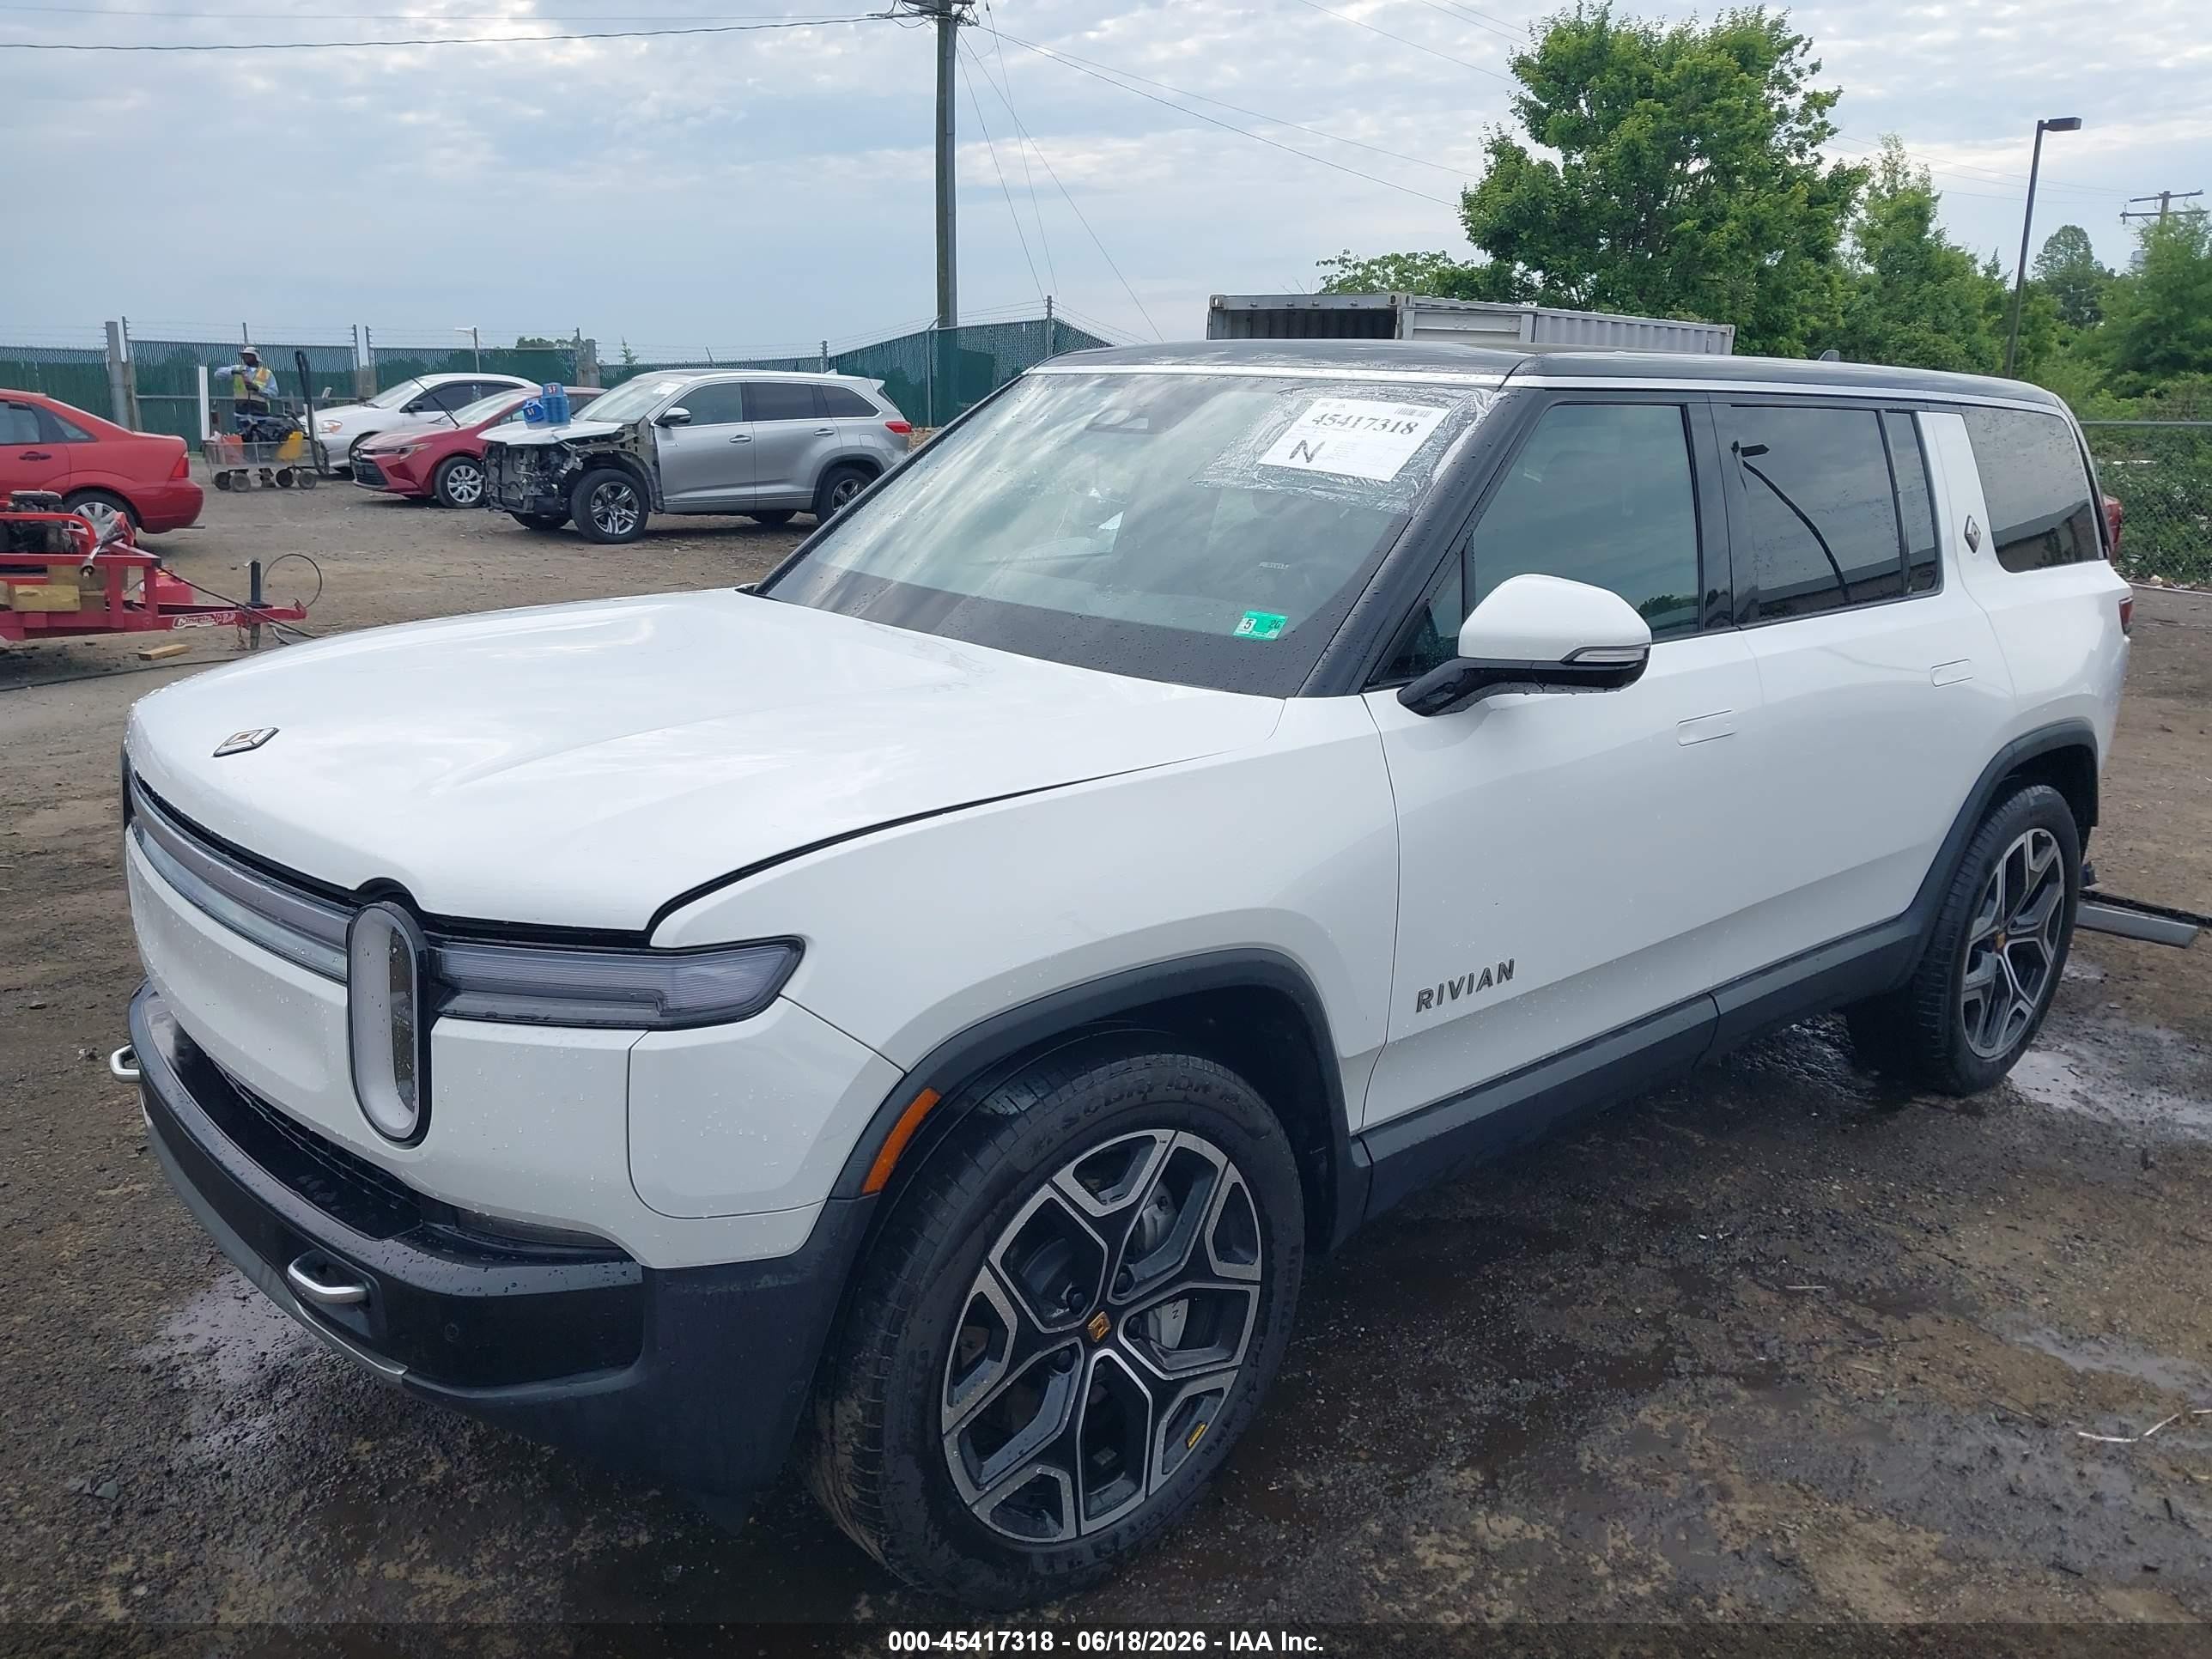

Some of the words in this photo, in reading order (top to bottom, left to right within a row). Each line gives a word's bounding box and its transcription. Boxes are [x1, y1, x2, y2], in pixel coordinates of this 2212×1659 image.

[1311, 413, 1419, 435] 45417318
[1289, 440, 1326, 463] N
[1243, 618, 1254, 629] 5
[1415, 957, 1515, 1013] RIVIAN
